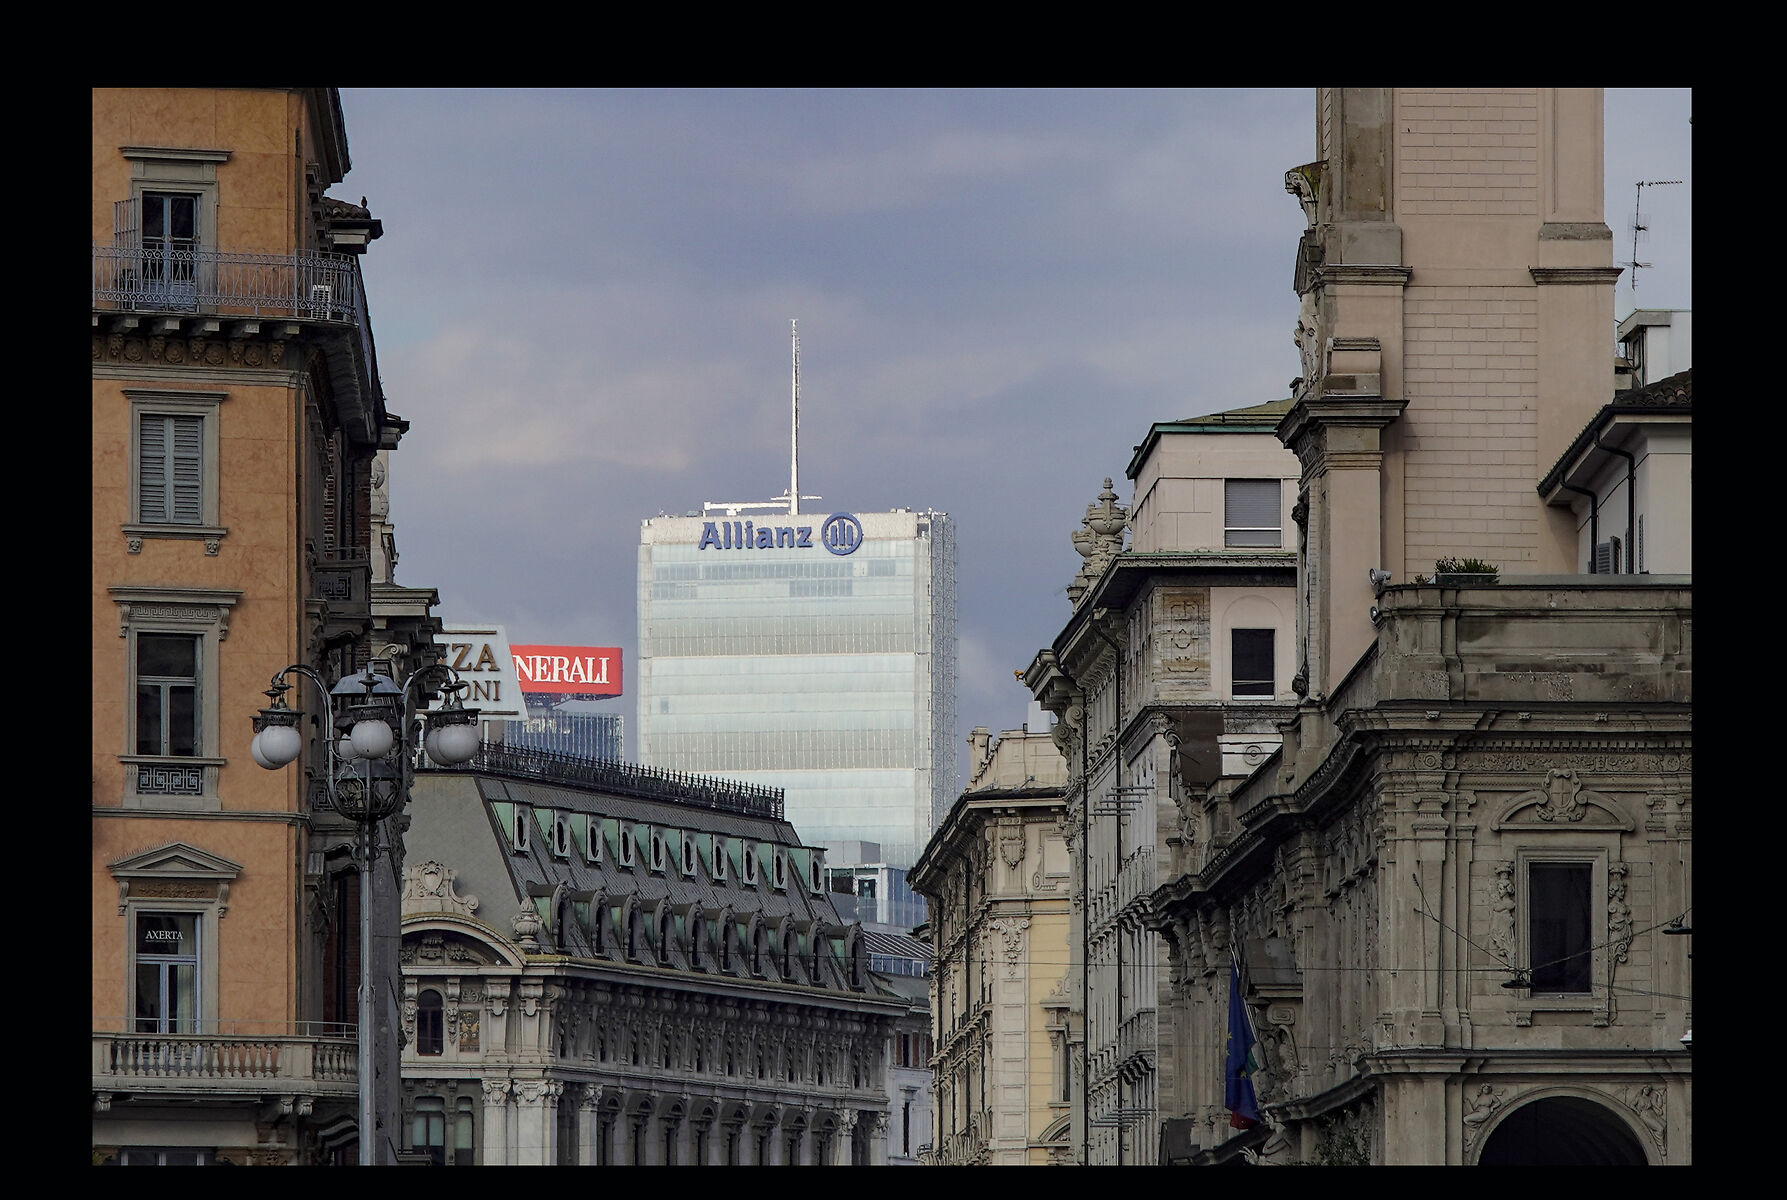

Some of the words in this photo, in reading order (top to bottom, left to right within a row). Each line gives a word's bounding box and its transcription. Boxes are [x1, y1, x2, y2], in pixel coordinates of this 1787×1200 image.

[699, 520, 813, 550] Allianz
[512, 655, 610, 684] NERALI
[145, 930, 183, 940] AXERTA
